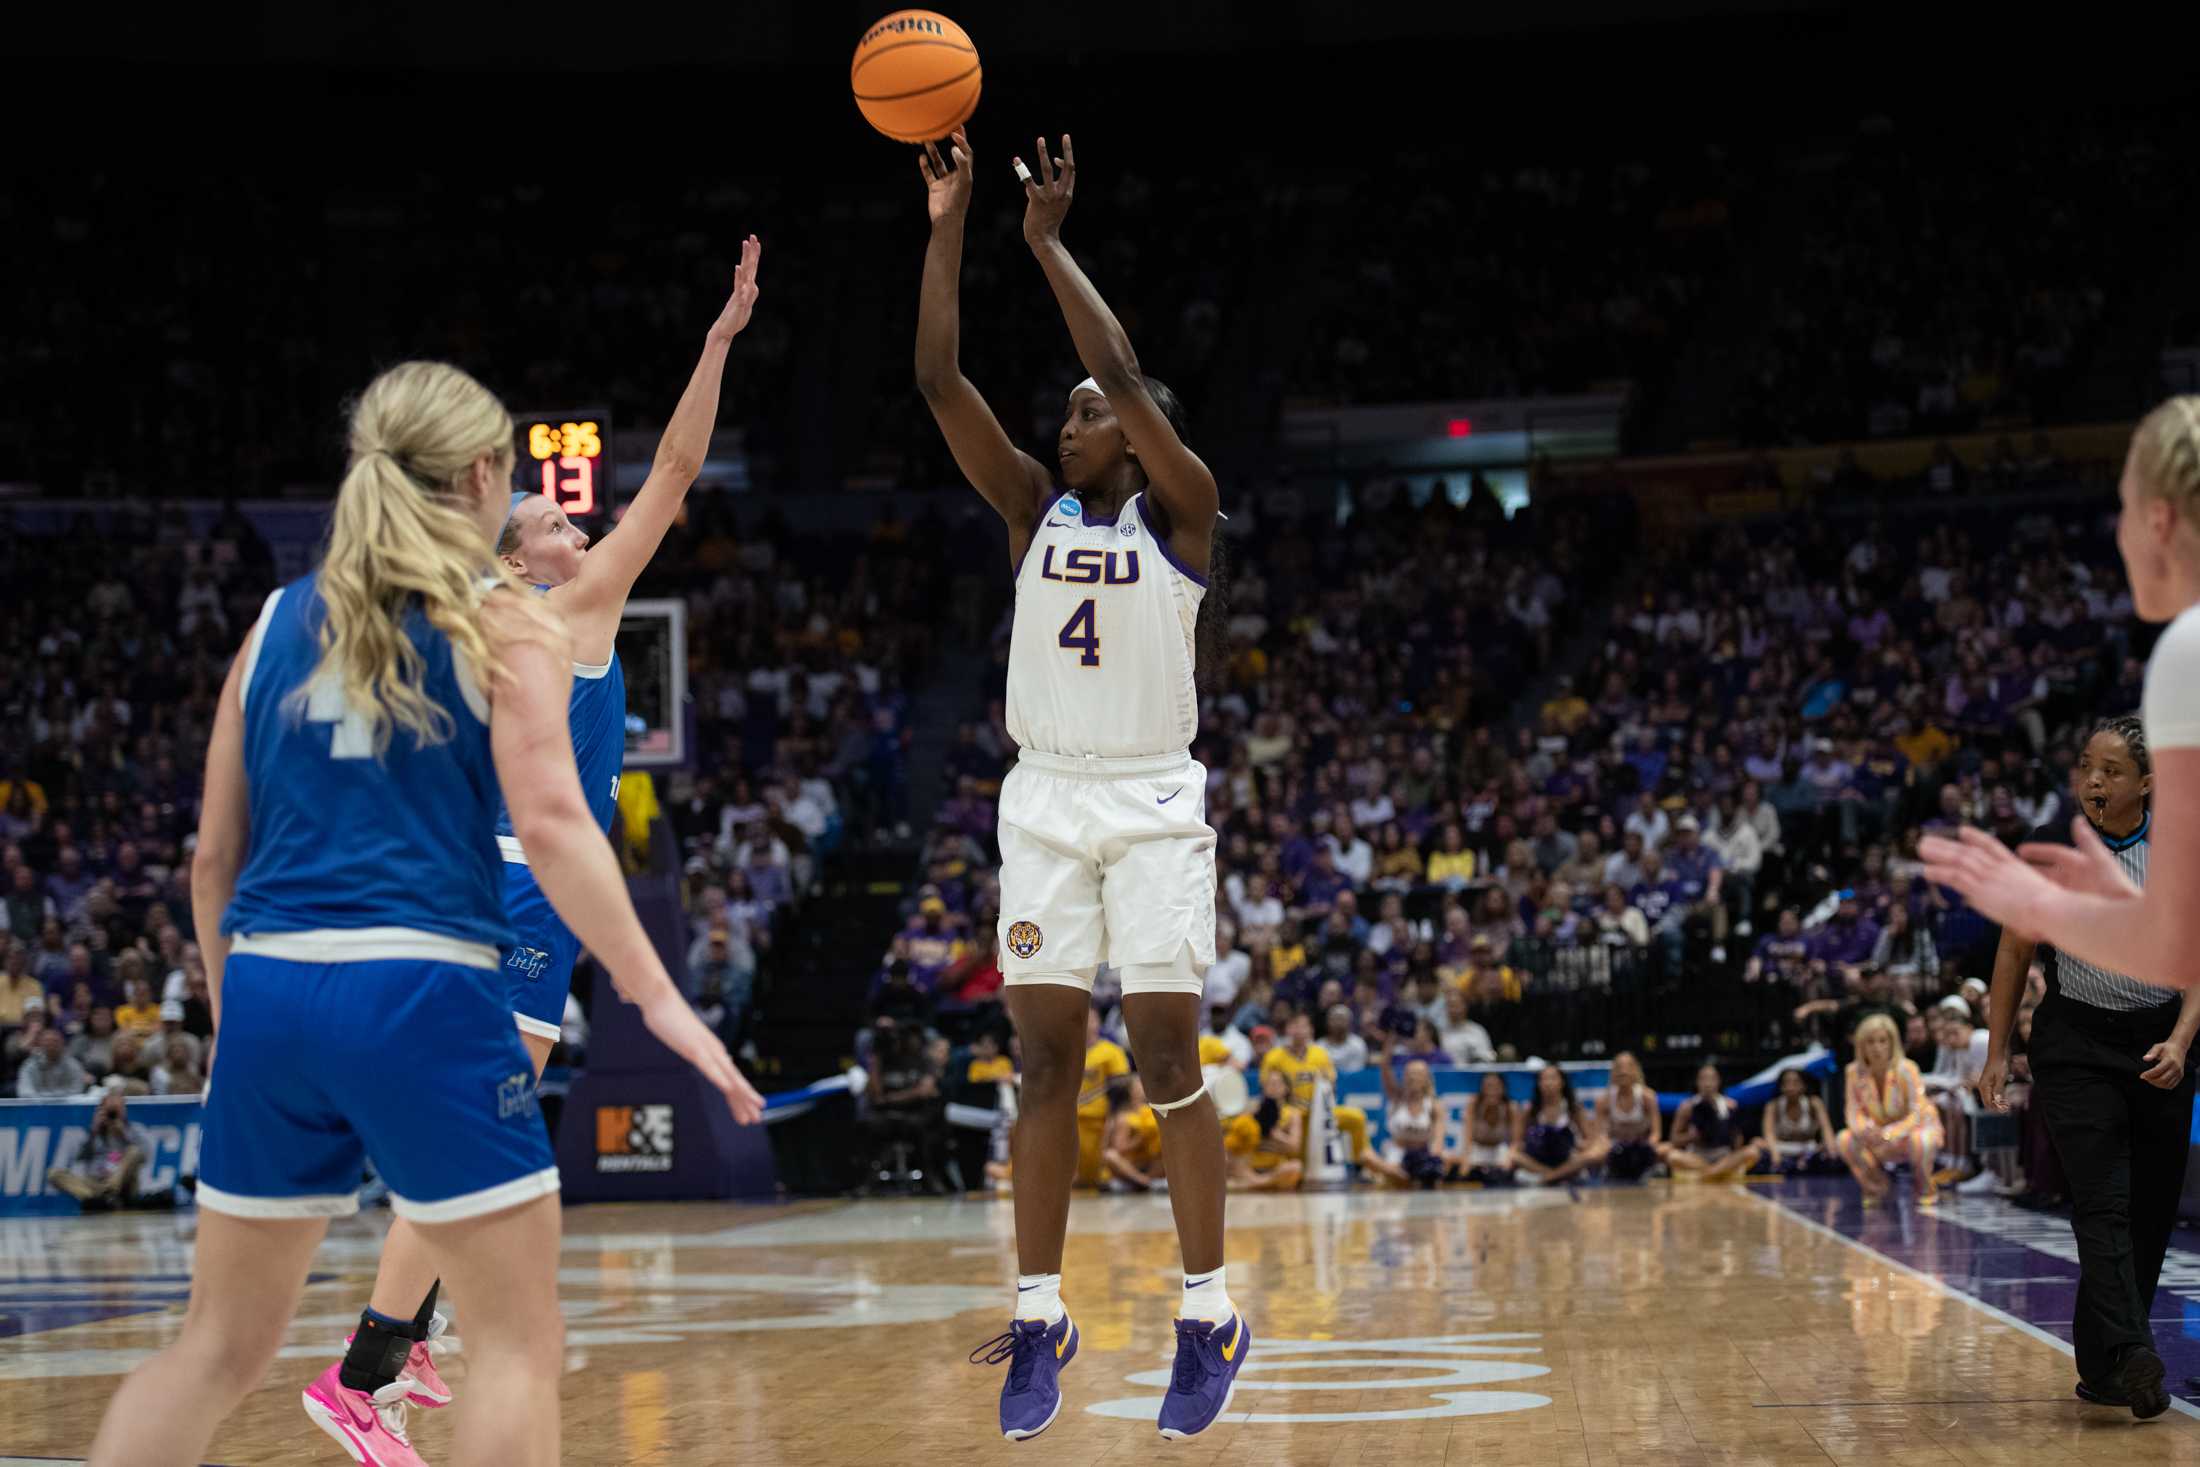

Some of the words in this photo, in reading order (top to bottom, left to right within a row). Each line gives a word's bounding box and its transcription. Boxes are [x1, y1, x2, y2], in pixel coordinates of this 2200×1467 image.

[529, 422, 602, 460] 6:35
[542, 456, 593, 514] 13
[1120, 523, 1137, 537] SEC
[1041, 543, 1141, 586] LSU
[1058, 598, 1101, 667] 4
